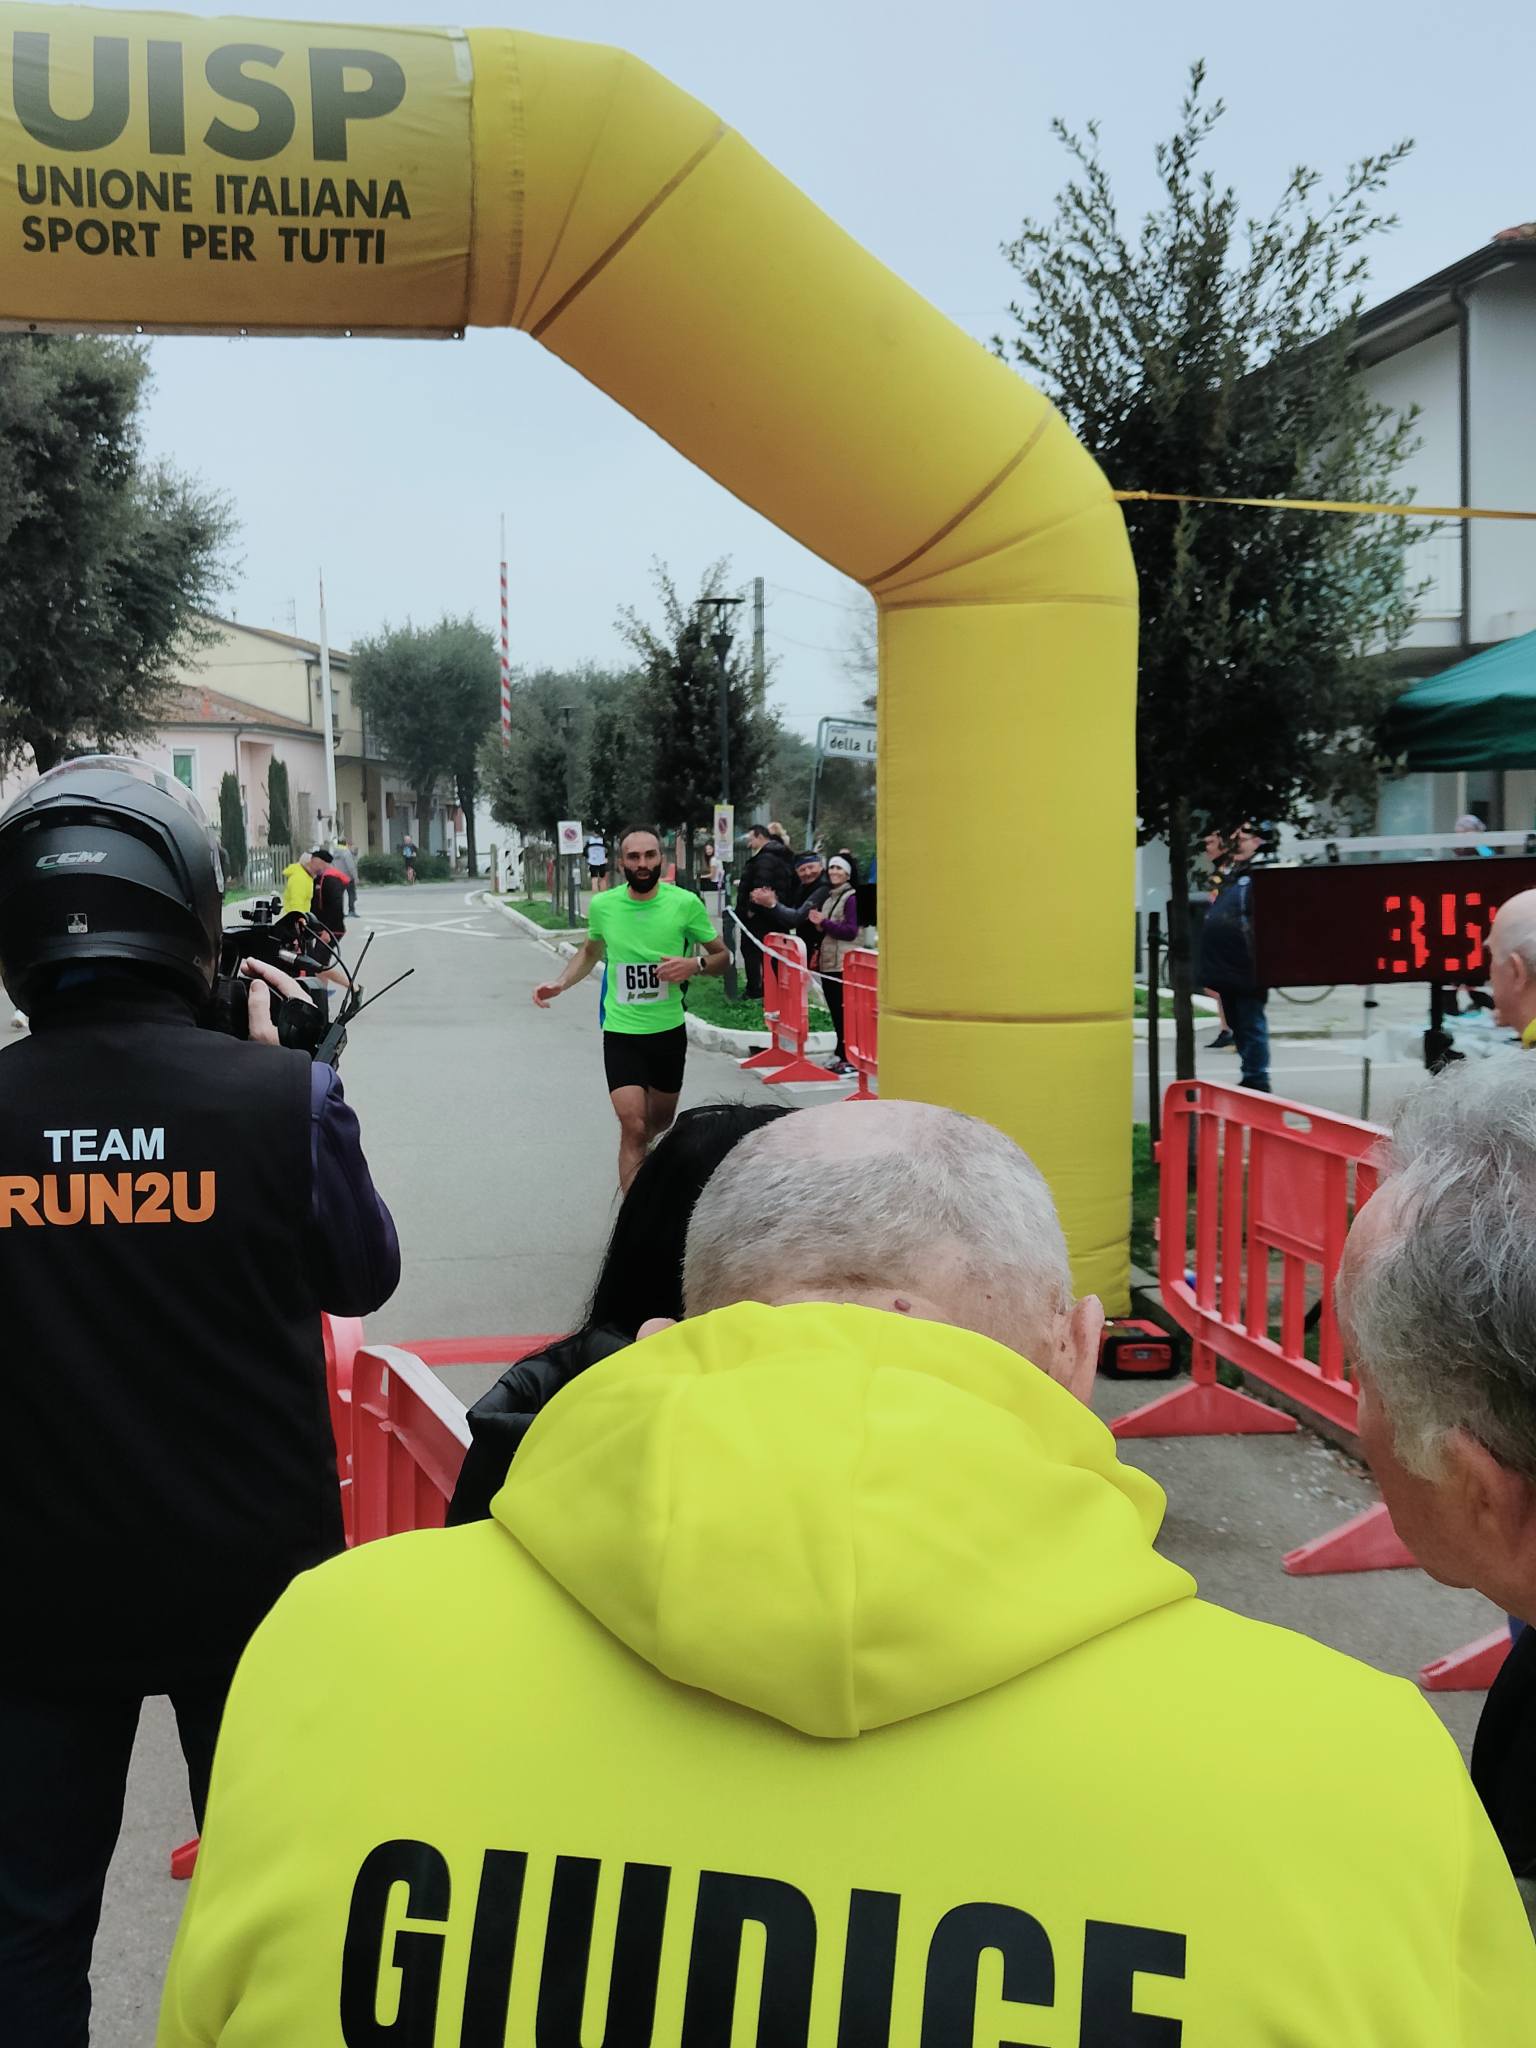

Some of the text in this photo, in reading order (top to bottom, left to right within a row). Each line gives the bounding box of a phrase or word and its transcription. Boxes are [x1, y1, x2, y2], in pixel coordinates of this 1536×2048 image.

[13, 31, 406, 162] UISP
[17, 164, 411, 220] UNIONE ITALIANA
[22, 215, 386, 265] SPORT PER TUTTI
[829, 736, 861, 751] della
[626, 964, 660, 990] 658
[43, 1127, 165, 1163] TEAM
[0, 1170, 216, 1228] RUN2U
